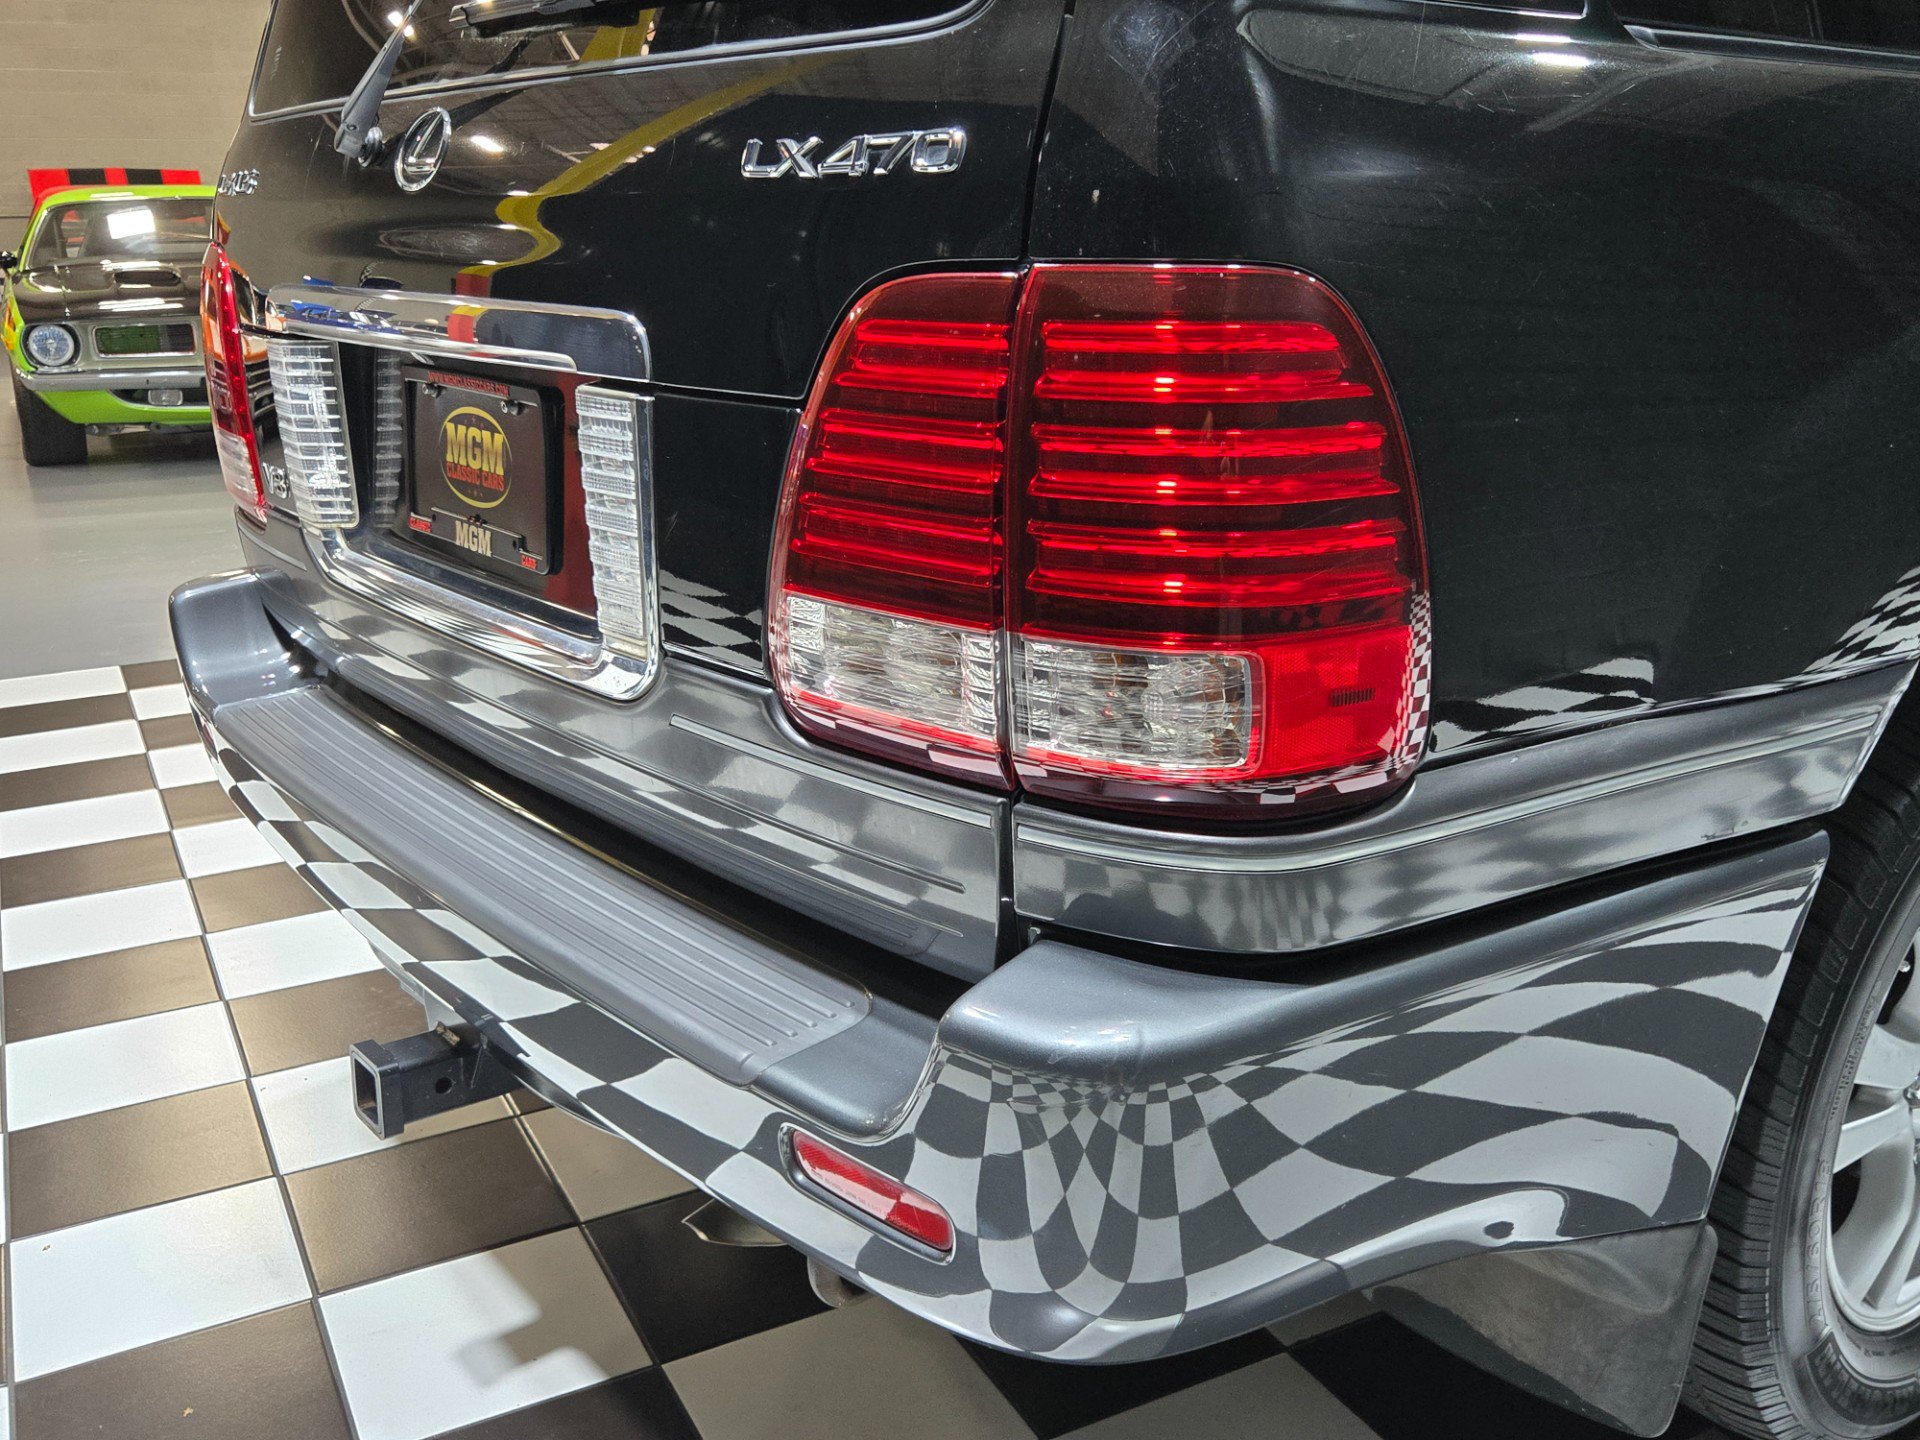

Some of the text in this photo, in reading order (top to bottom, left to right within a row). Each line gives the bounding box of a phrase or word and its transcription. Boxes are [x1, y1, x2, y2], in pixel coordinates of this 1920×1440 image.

[445, 421, 505, 476] MGM
[262, 461, 288, 499] V8
[446, 461, 505, 492] CLASSIC CARS
[454, 520, 493, 557] MGM
